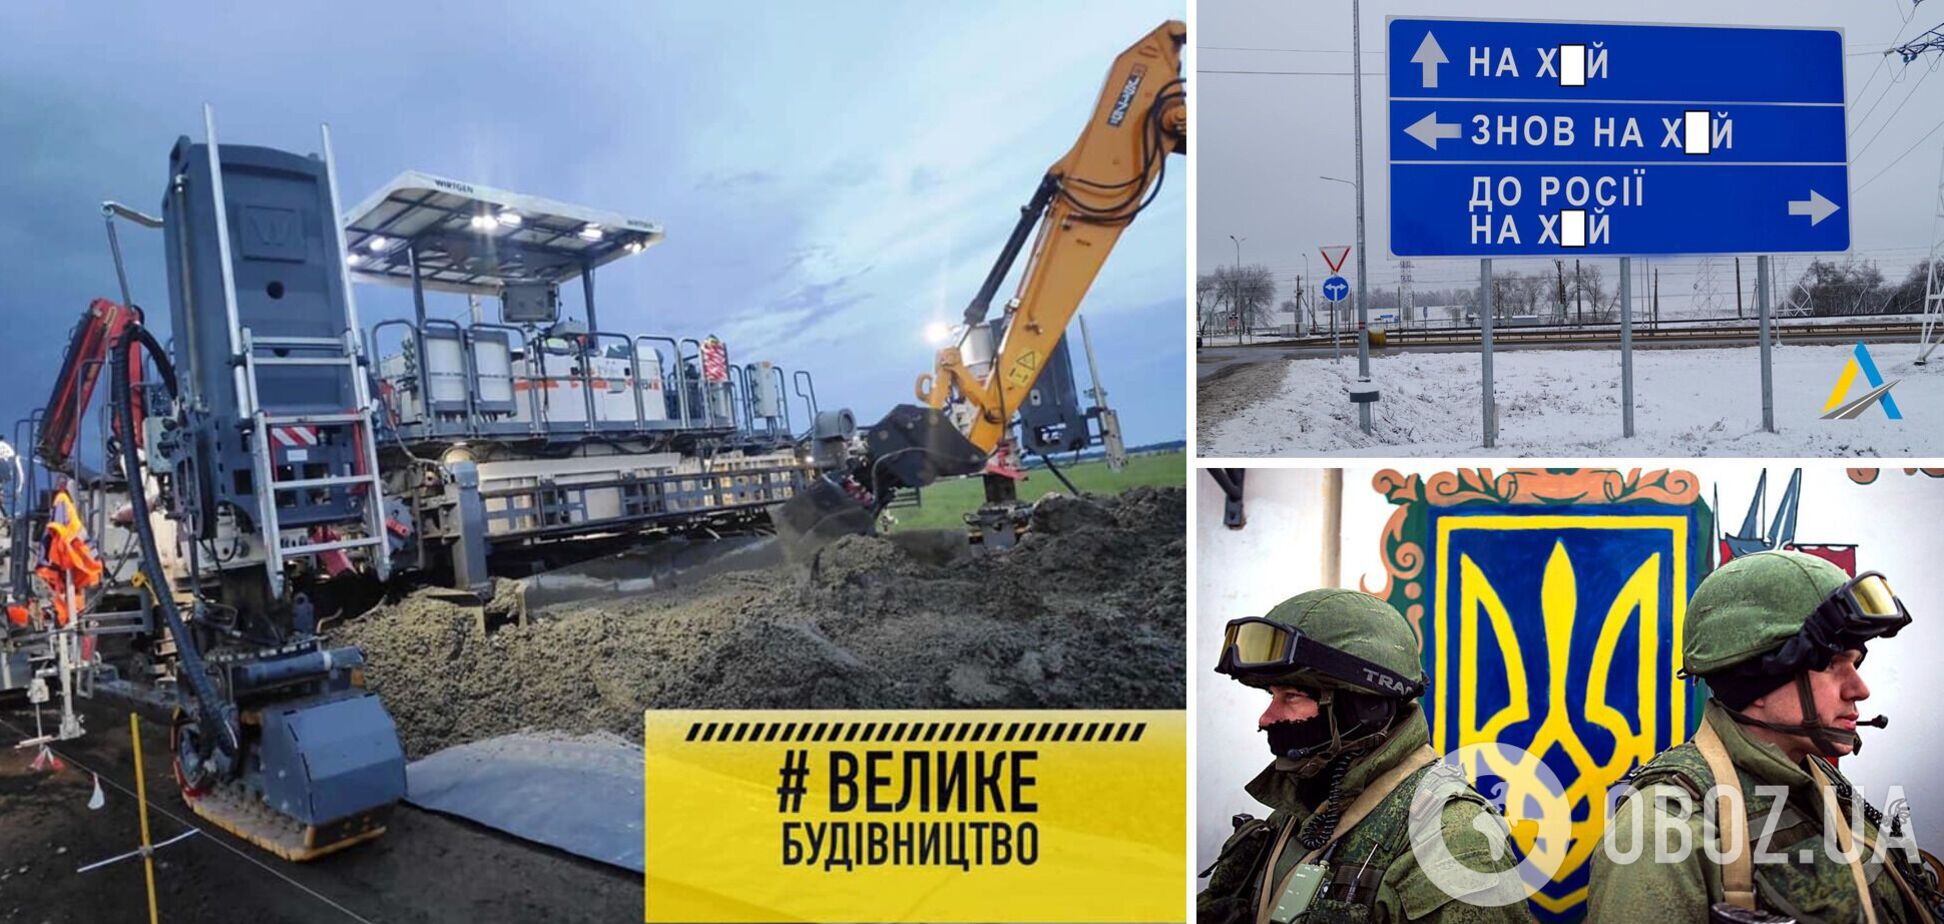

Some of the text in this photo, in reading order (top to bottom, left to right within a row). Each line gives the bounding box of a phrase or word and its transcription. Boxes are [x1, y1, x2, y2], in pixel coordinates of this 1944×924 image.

[1469, 41, 1608, 79] НА ХЙ
[1471, 111, 1733, 149] ЗНОВ НА ХЙ
[1468, 168, 1646, 213] ДО РОСІЇ
[1471, 206, 1610, 245] НА ХЙ
